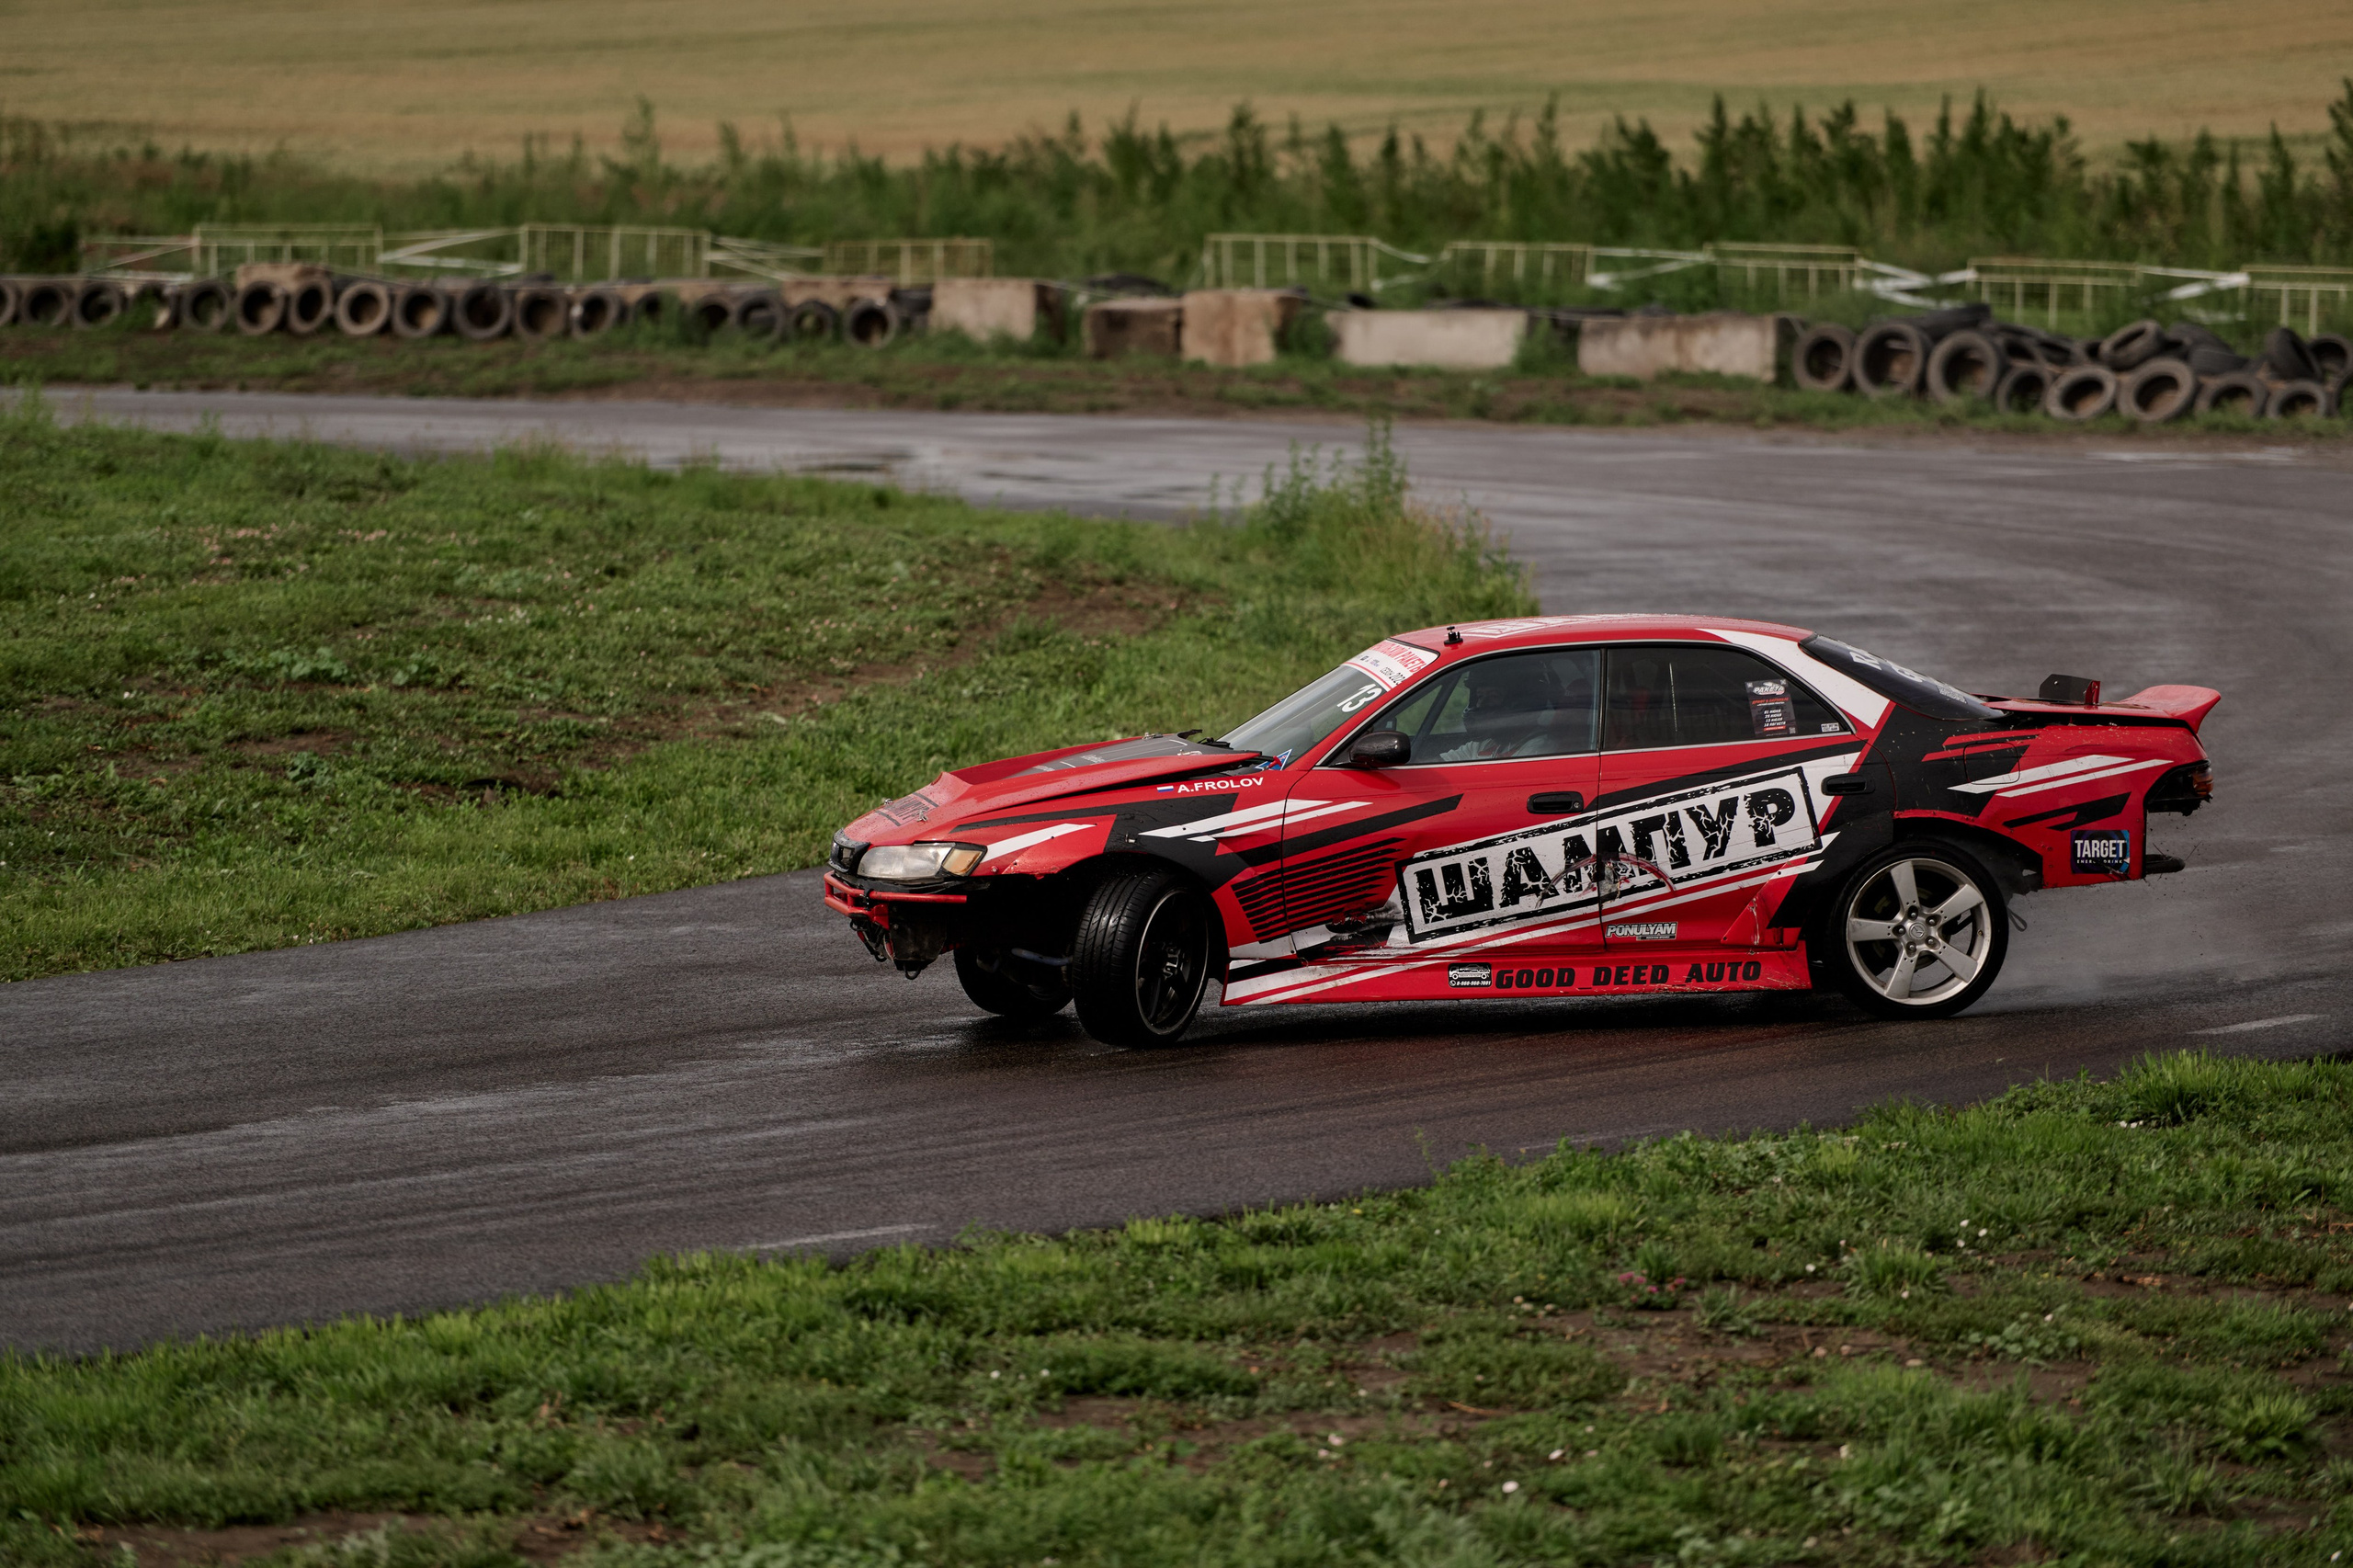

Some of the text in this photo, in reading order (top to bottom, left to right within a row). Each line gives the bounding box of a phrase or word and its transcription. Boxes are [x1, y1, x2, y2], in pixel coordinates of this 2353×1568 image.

[1336, 683, 1382, 712] 13
[1177, 777, 1264, 793] A.FROLOV
[1414, 787, 1796, 925] ШАМПУР
[2075, 839, 2126, 858] TARGET
[1607, 922, 1677, 937] PONULYAM
